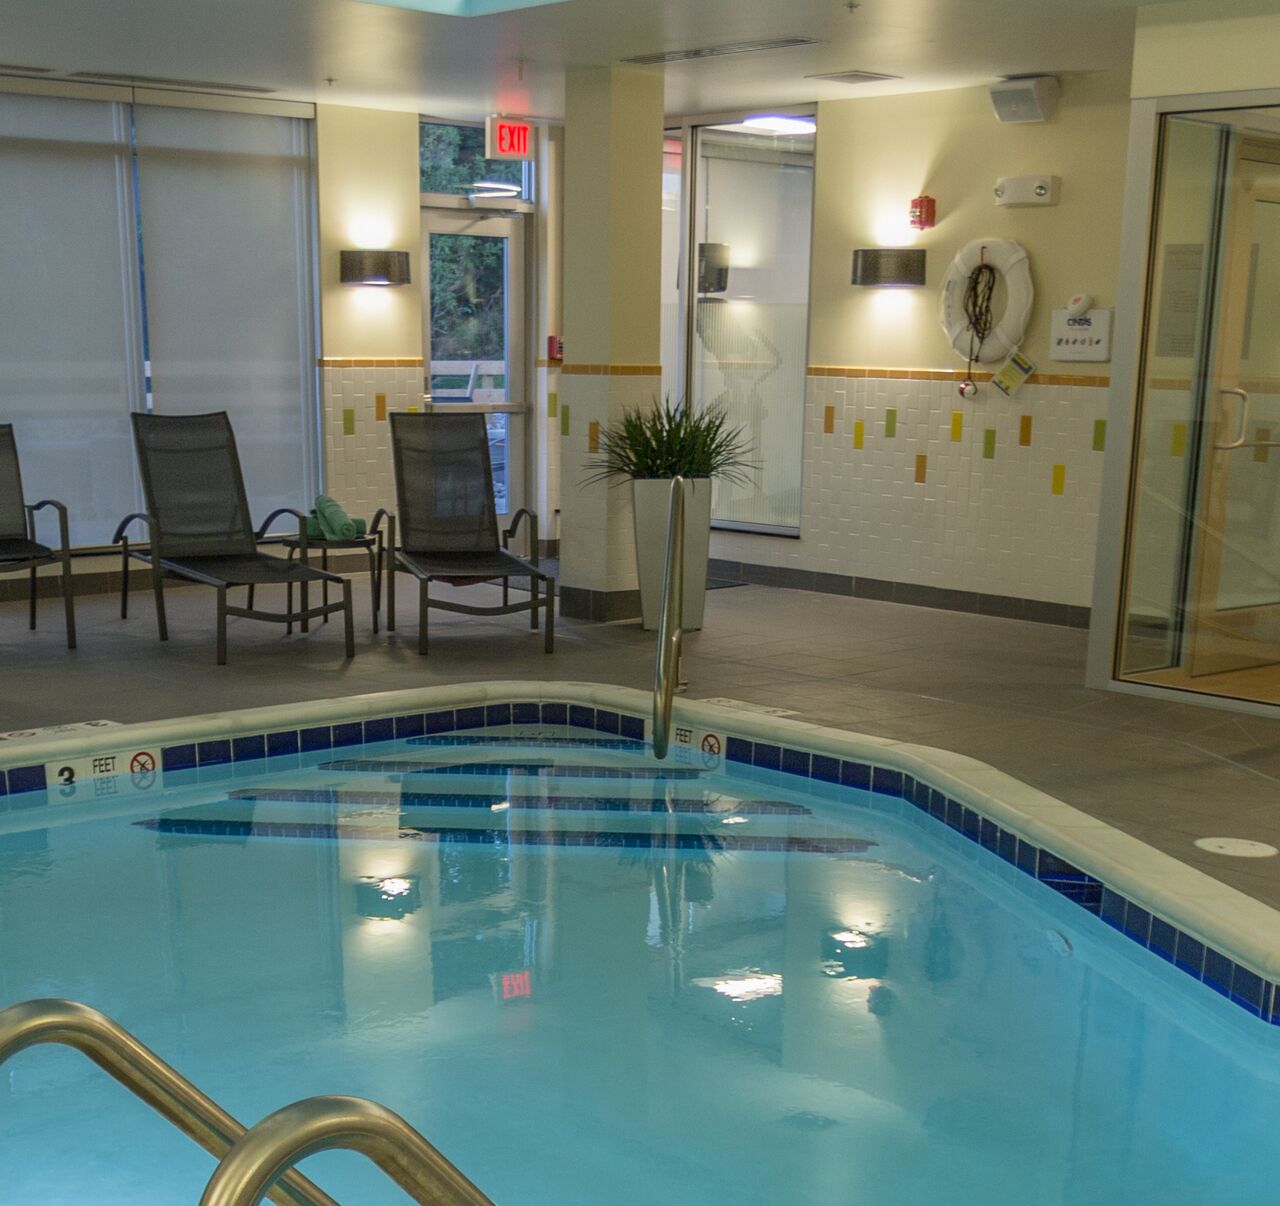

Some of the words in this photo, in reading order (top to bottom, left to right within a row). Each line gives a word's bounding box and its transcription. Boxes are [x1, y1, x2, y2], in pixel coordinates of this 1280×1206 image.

[497, 124, 529, 155] EXIT
[675, 728, 693, 744] FEET
[57, 766, 76, 786] 3
[92, 756, 116, 774] FEET
